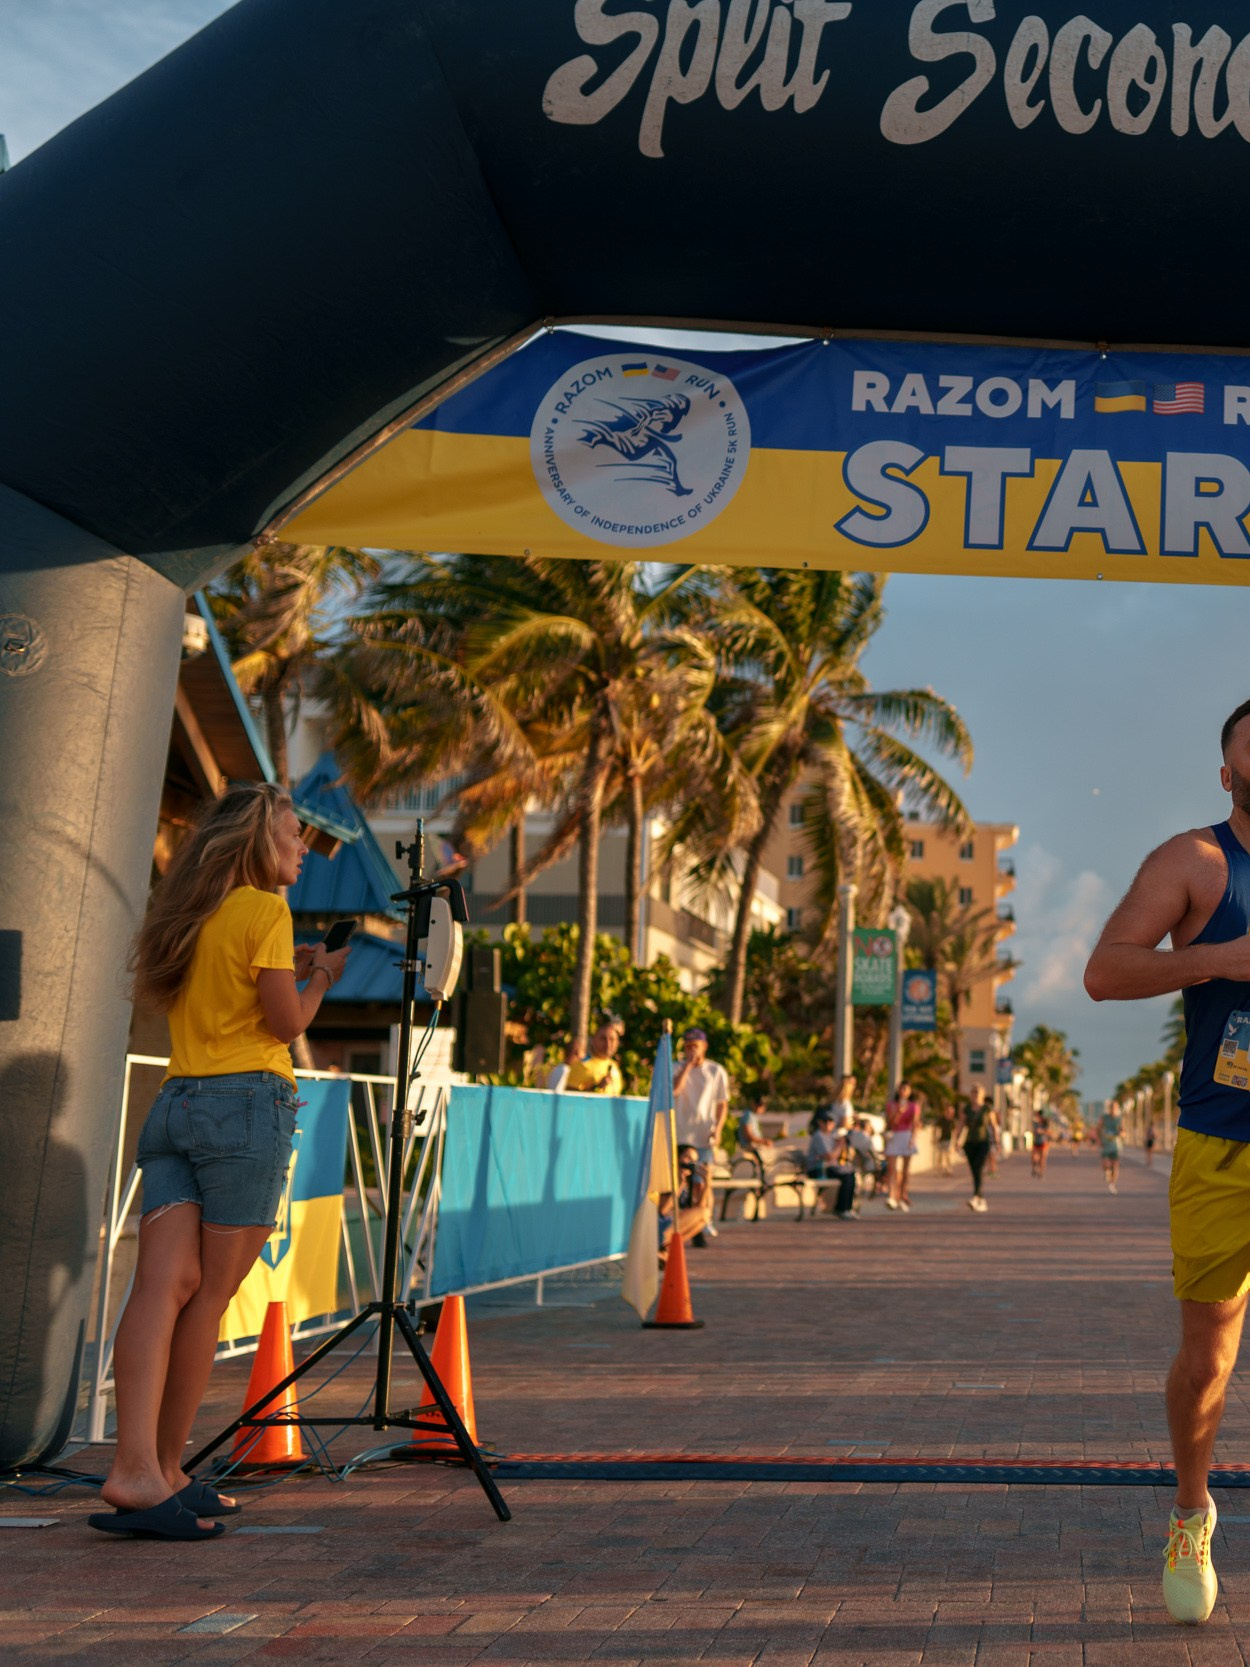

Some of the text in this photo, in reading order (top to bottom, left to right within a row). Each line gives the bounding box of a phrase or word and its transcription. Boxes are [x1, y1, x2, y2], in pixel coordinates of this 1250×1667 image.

[542, 0, 853, 158] Split
[554, 366, 721, 415] RAZOM RUN
[851, 369, 1077, 419] RAZOM
[543, 412, 739, 535] ANNIVERSARY OF INDEPENDENCE OF UKRAINE 5K RUN
